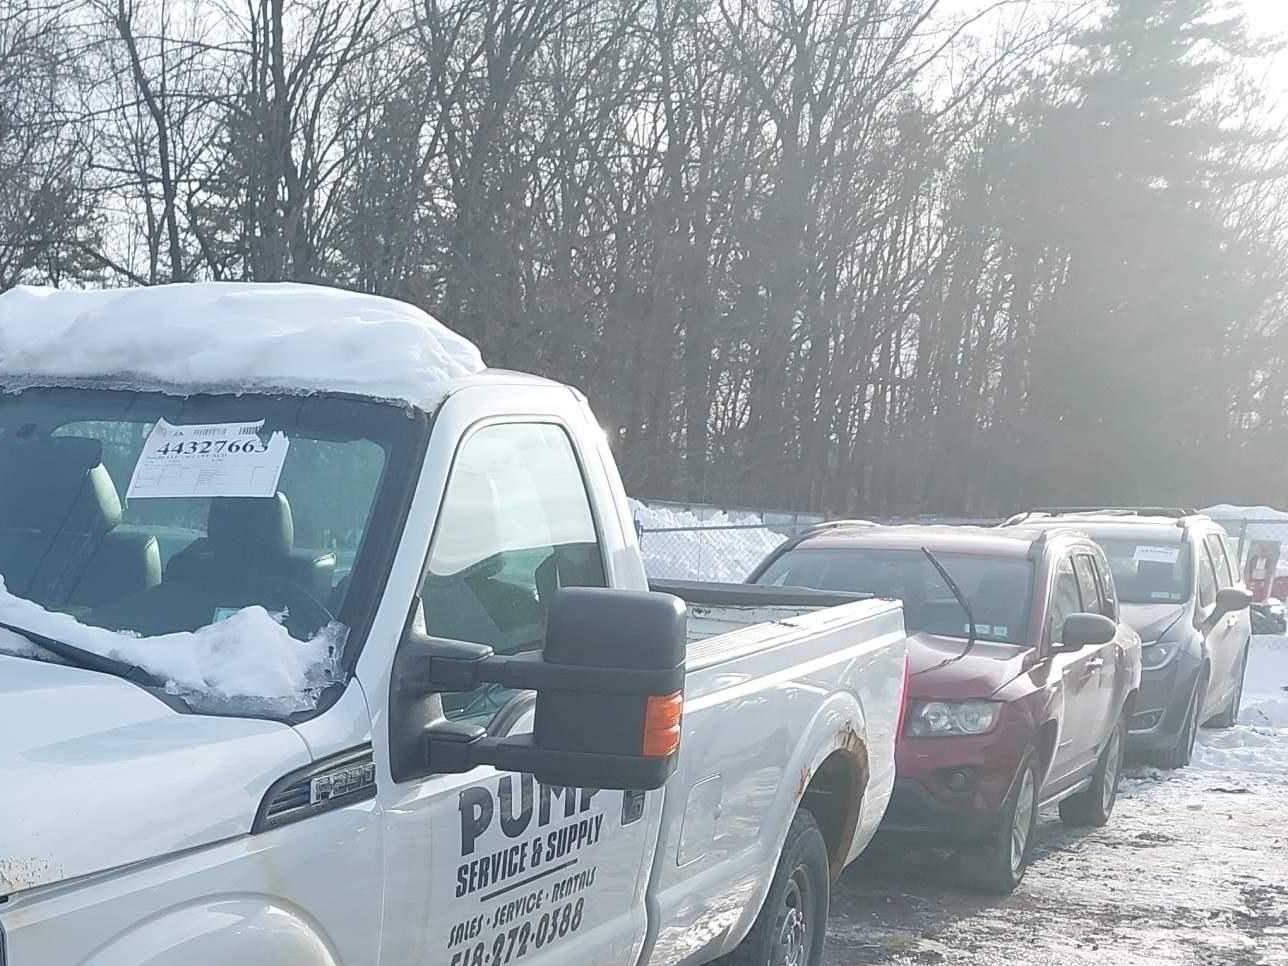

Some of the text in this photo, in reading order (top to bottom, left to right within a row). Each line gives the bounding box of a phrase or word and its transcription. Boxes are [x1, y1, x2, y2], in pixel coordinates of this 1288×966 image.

[456, 813, 604, 898] SERVICE & SUPPLY
[448, 866, 597, 949] SALES SERVICE RENTALS
